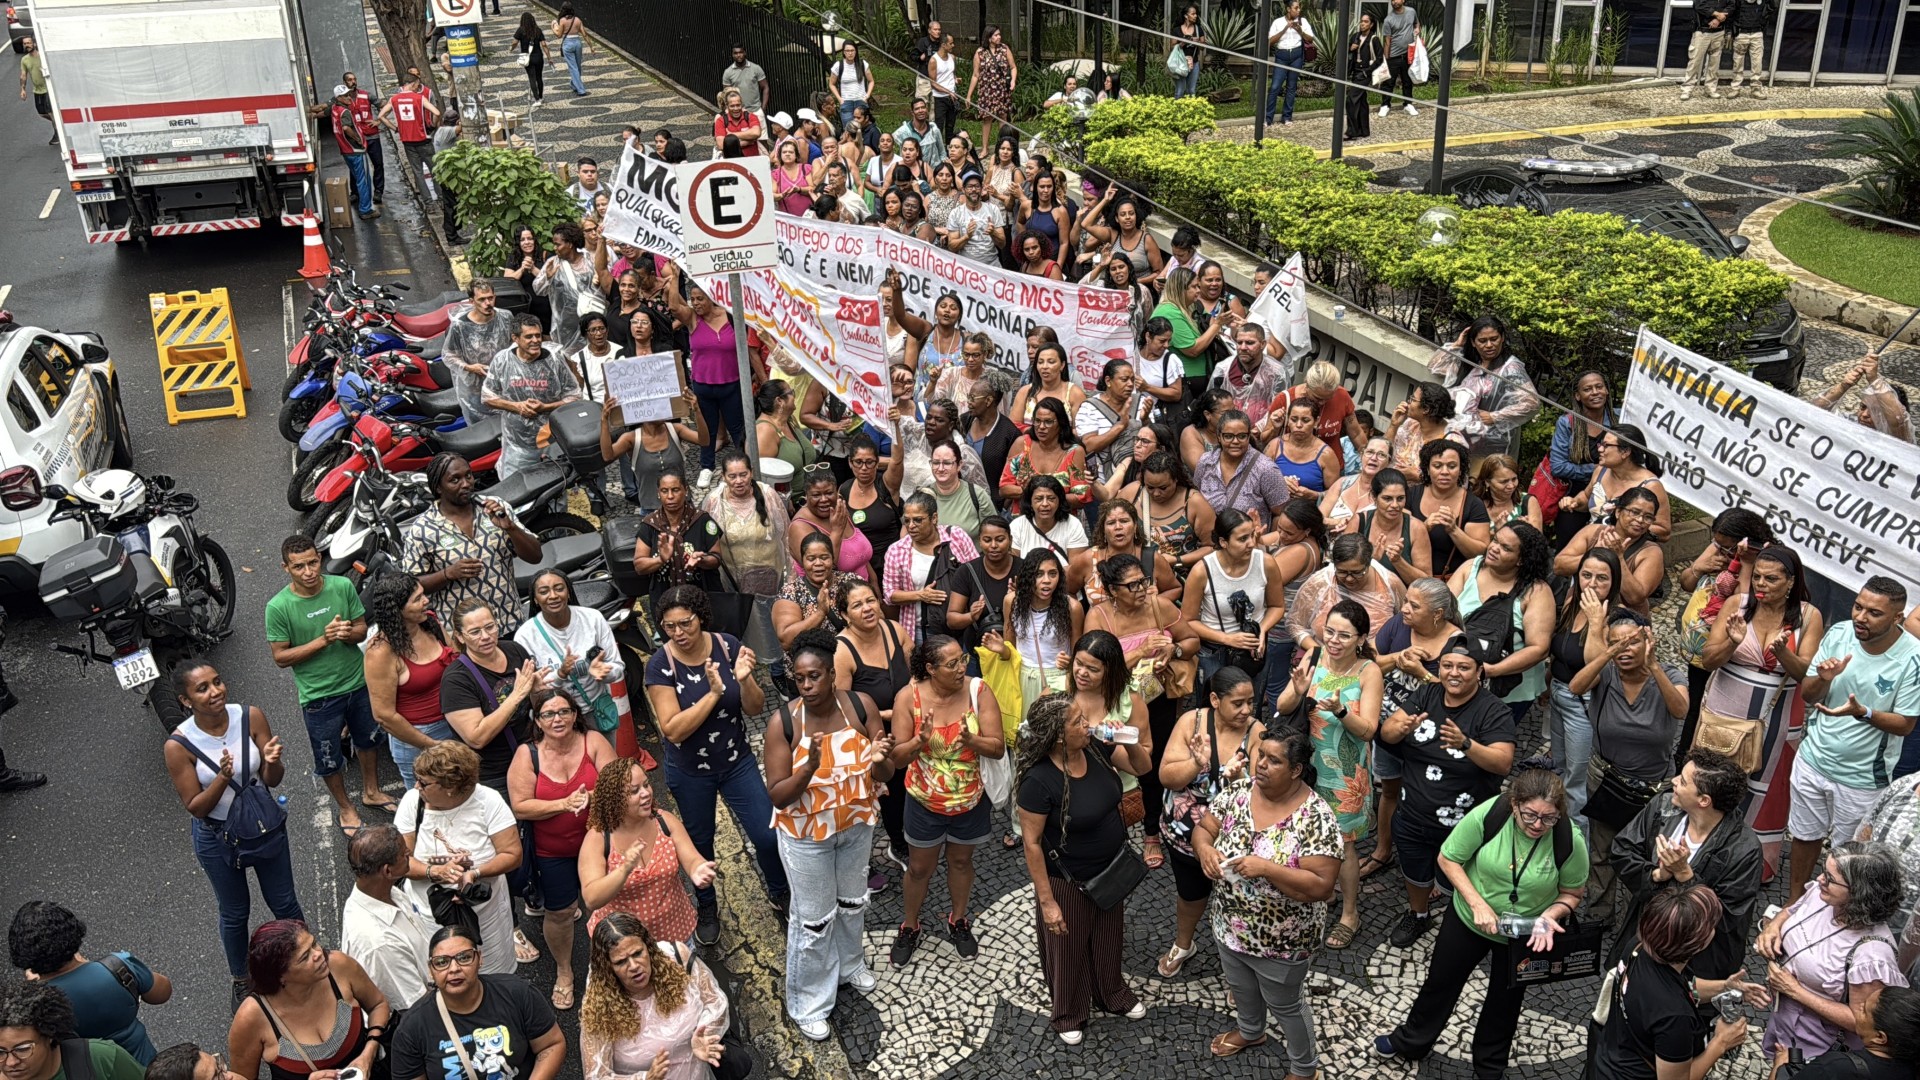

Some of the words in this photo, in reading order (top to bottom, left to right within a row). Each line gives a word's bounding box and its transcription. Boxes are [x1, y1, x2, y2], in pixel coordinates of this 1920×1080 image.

[169, 118, 198, 127] REAL
[709, 176, 742, 225] E
[688, 242, 711, 252] INÍCIO
[710, 249, 754, 263] VEÍCULO
[713, 259, 753, 272] OFICIAL
[803, 250, 812, 274] É
[819, 258, 828, 278] E
[837, 261, 874, 286] NEM
[835, 232, 864, 256] dos
[875, 234, 988, 294] trabalhadores
[993, 277, 1015, 304] da
[1019, 281, 1064, 316] MGS
[1083, 290, 1124, 309] CSP
[1638, 343, 1763, 440] NATÁLIA,
[1768, 416, 1806, 449] SE
[1810, 434, 1834, 461] O
[1843, 449, 1900, 490] QUE
[1646, 401, 1705, 451] FALA
[1711, 434, 1767, 479] NÃO
[1772, 465, 1811, 498] SE
[1815, 485, 1920, 554] CUMPR
[1660, 450, 1706, 491] NÃO
[1762, 502, 1877, 575] ESCREVE
[124, 656, 147, 675] TDT
[123, 666, 156, 687] 3B92
